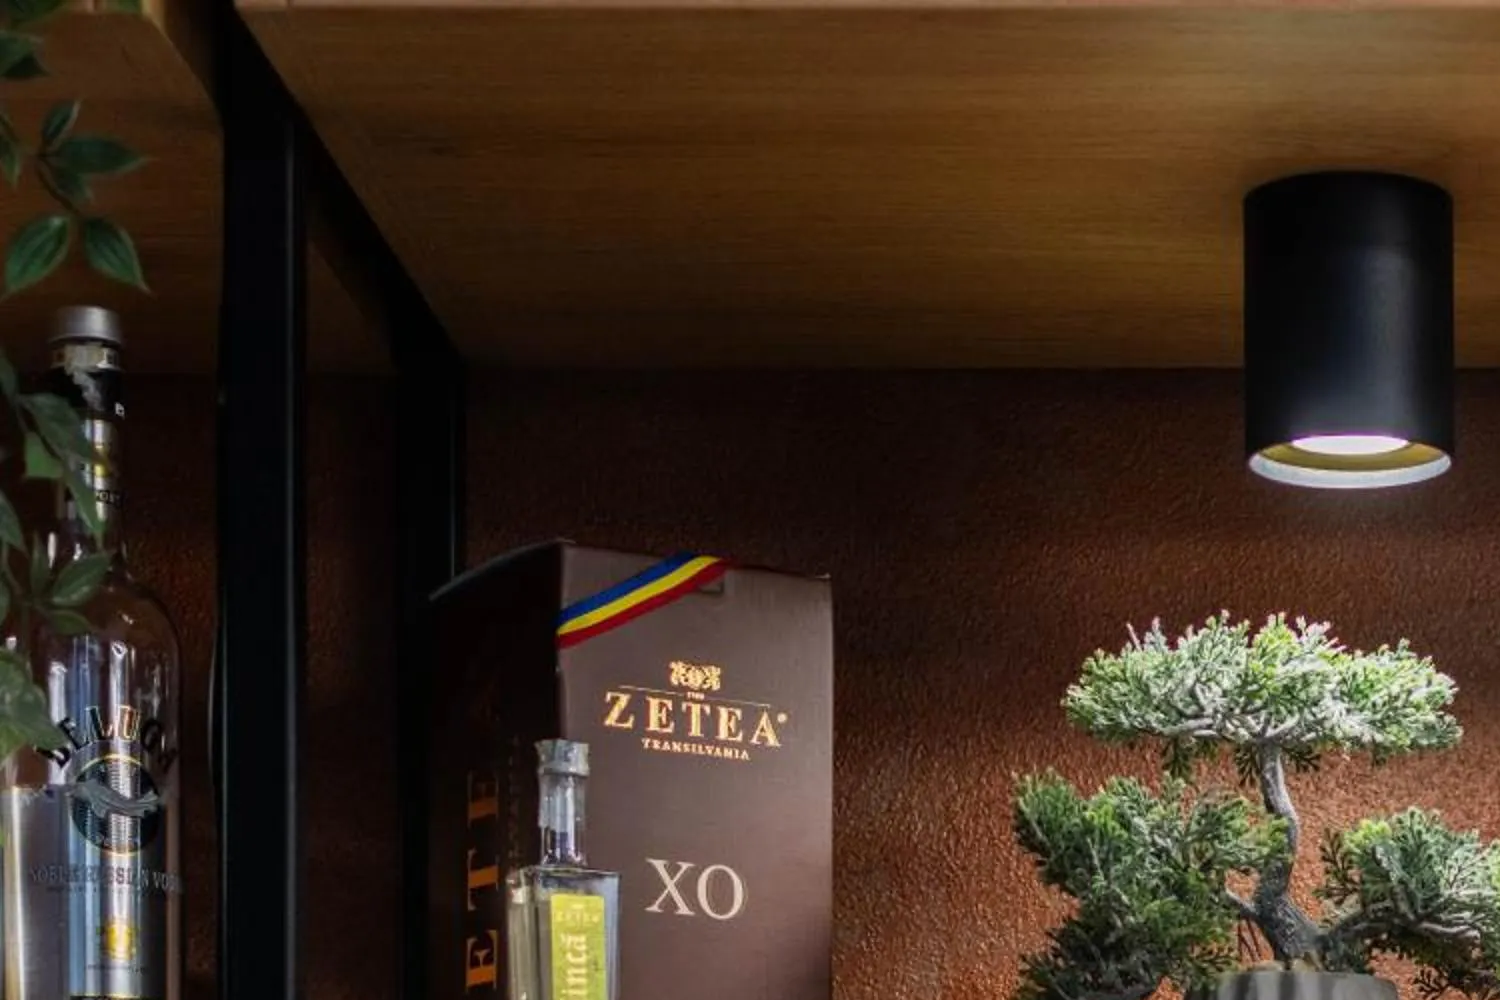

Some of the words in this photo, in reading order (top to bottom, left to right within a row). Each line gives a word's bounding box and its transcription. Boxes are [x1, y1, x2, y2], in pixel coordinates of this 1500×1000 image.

[603, 690, 782, 748] ZETEA
[641, 738, 752, 761] TRANSILVANIA
[644, 857, 745, 920] XO
